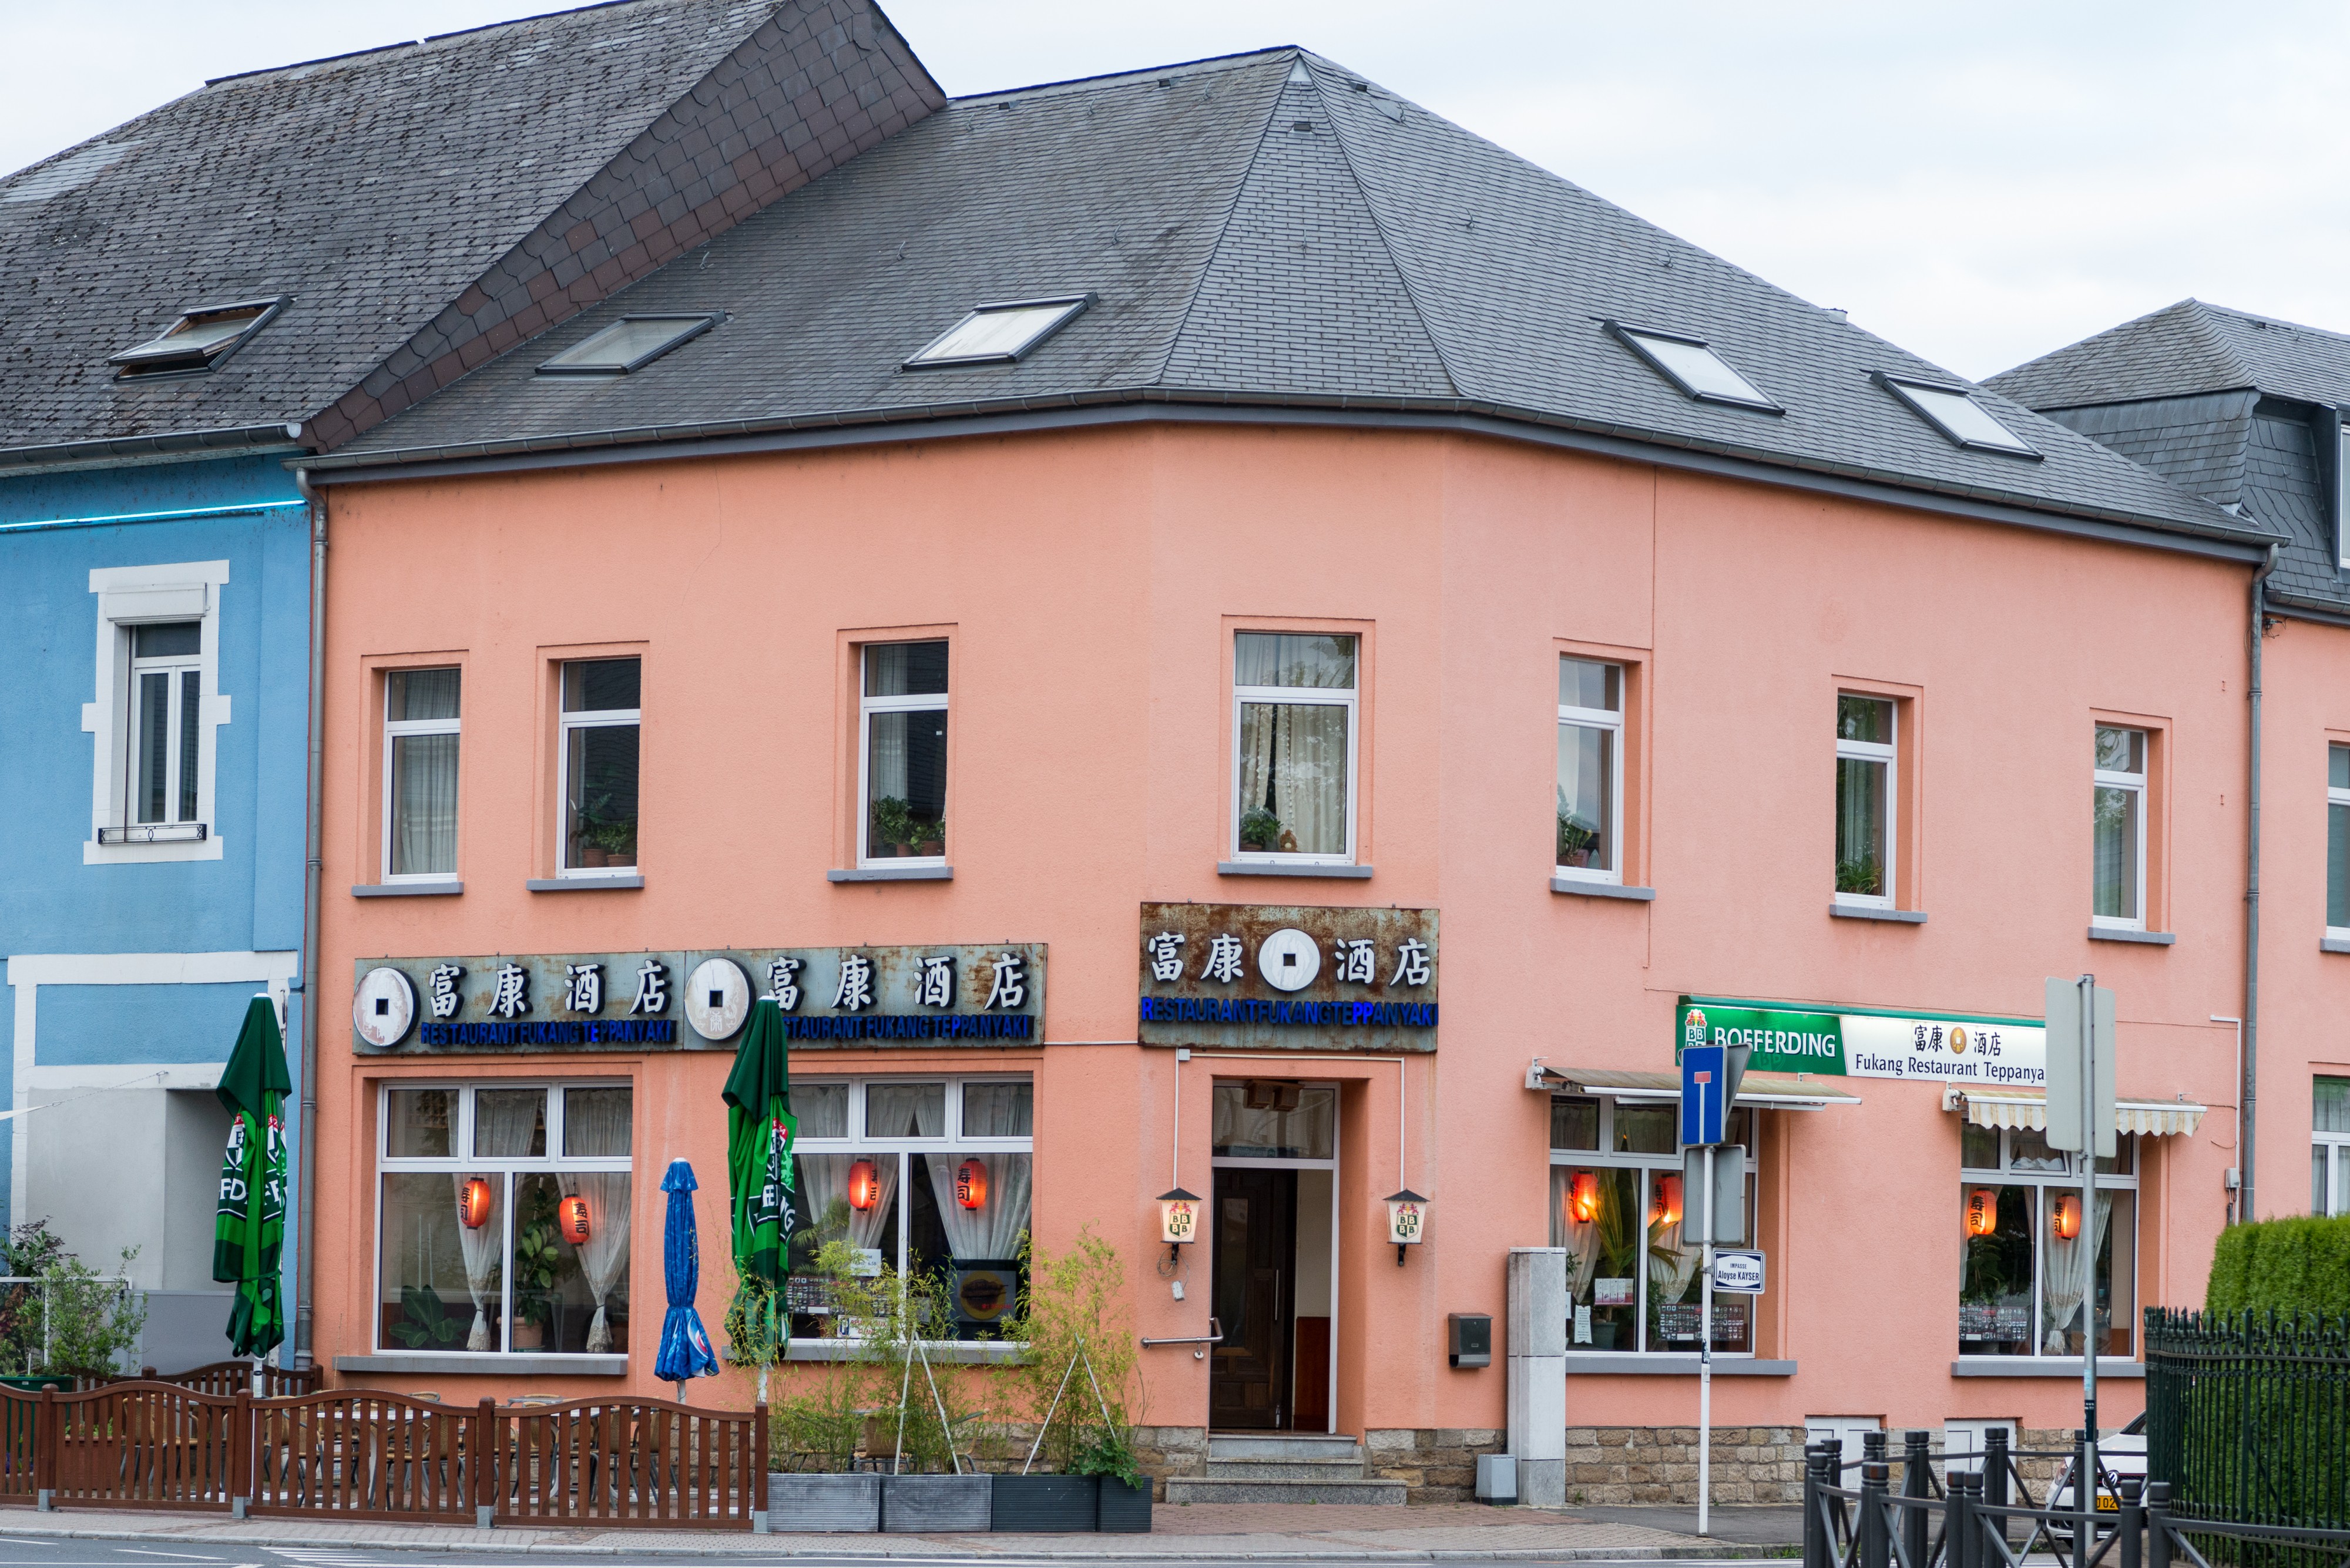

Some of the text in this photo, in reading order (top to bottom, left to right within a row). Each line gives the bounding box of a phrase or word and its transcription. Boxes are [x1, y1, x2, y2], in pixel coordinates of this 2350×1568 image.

[429, 959, 669, 1018] 富康酒店
[420, 1020, 673, 1044] RESTAURANT FUKANG TEPPANYAKI
[783, 1015, 1029, 1039] STAURANT FUKANG TEPPANYAKI
[1855, 1053, 2045, 1084] Fukang Restaurant Teppanya
[1718, 1270, 1760, 1281] Aloyse KAYSER
